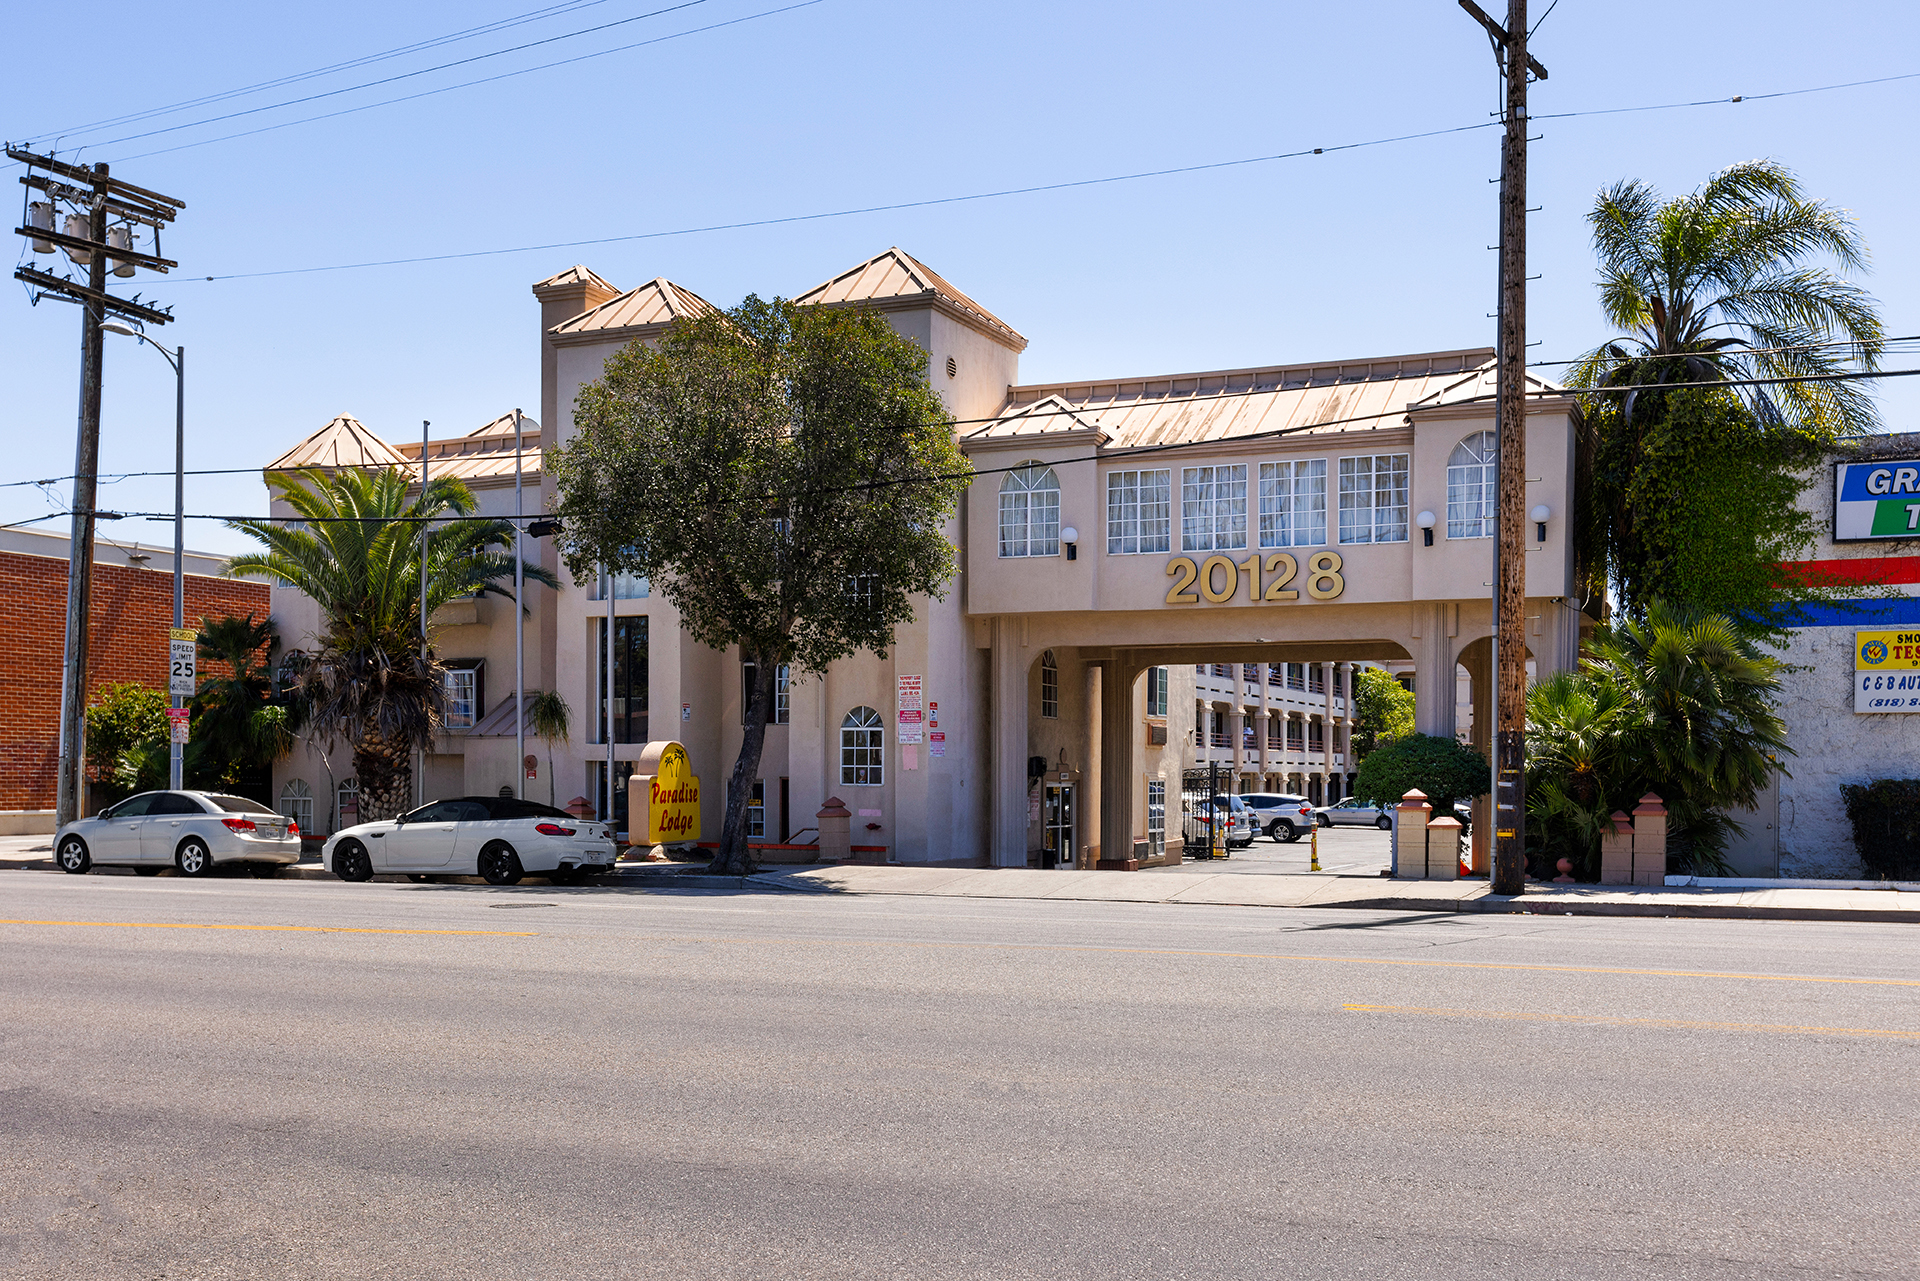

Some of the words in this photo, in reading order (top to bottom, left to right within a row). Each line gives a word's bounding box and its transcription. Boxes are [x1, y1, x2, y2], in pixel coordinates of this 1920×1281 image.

[1866, 467, 1920, 496] GR
[1165, 551, 1345, 604] 20128
[171, 630, 195, 640] SCHOOL
[172, 644, 194, 653] SPEED
[172, 661, 194, 678] 25
[1863, 676, 1871, 691] C
[1874, 676, 1883, 691] &
[1887, 676, 1895, 691] B
[1868, 698, 1905, 708] (818)
[1909, 698, 1920, 706] 8
[652, 781, 698, 805] Paradise
[658, 809, 693, 836] Lodge
